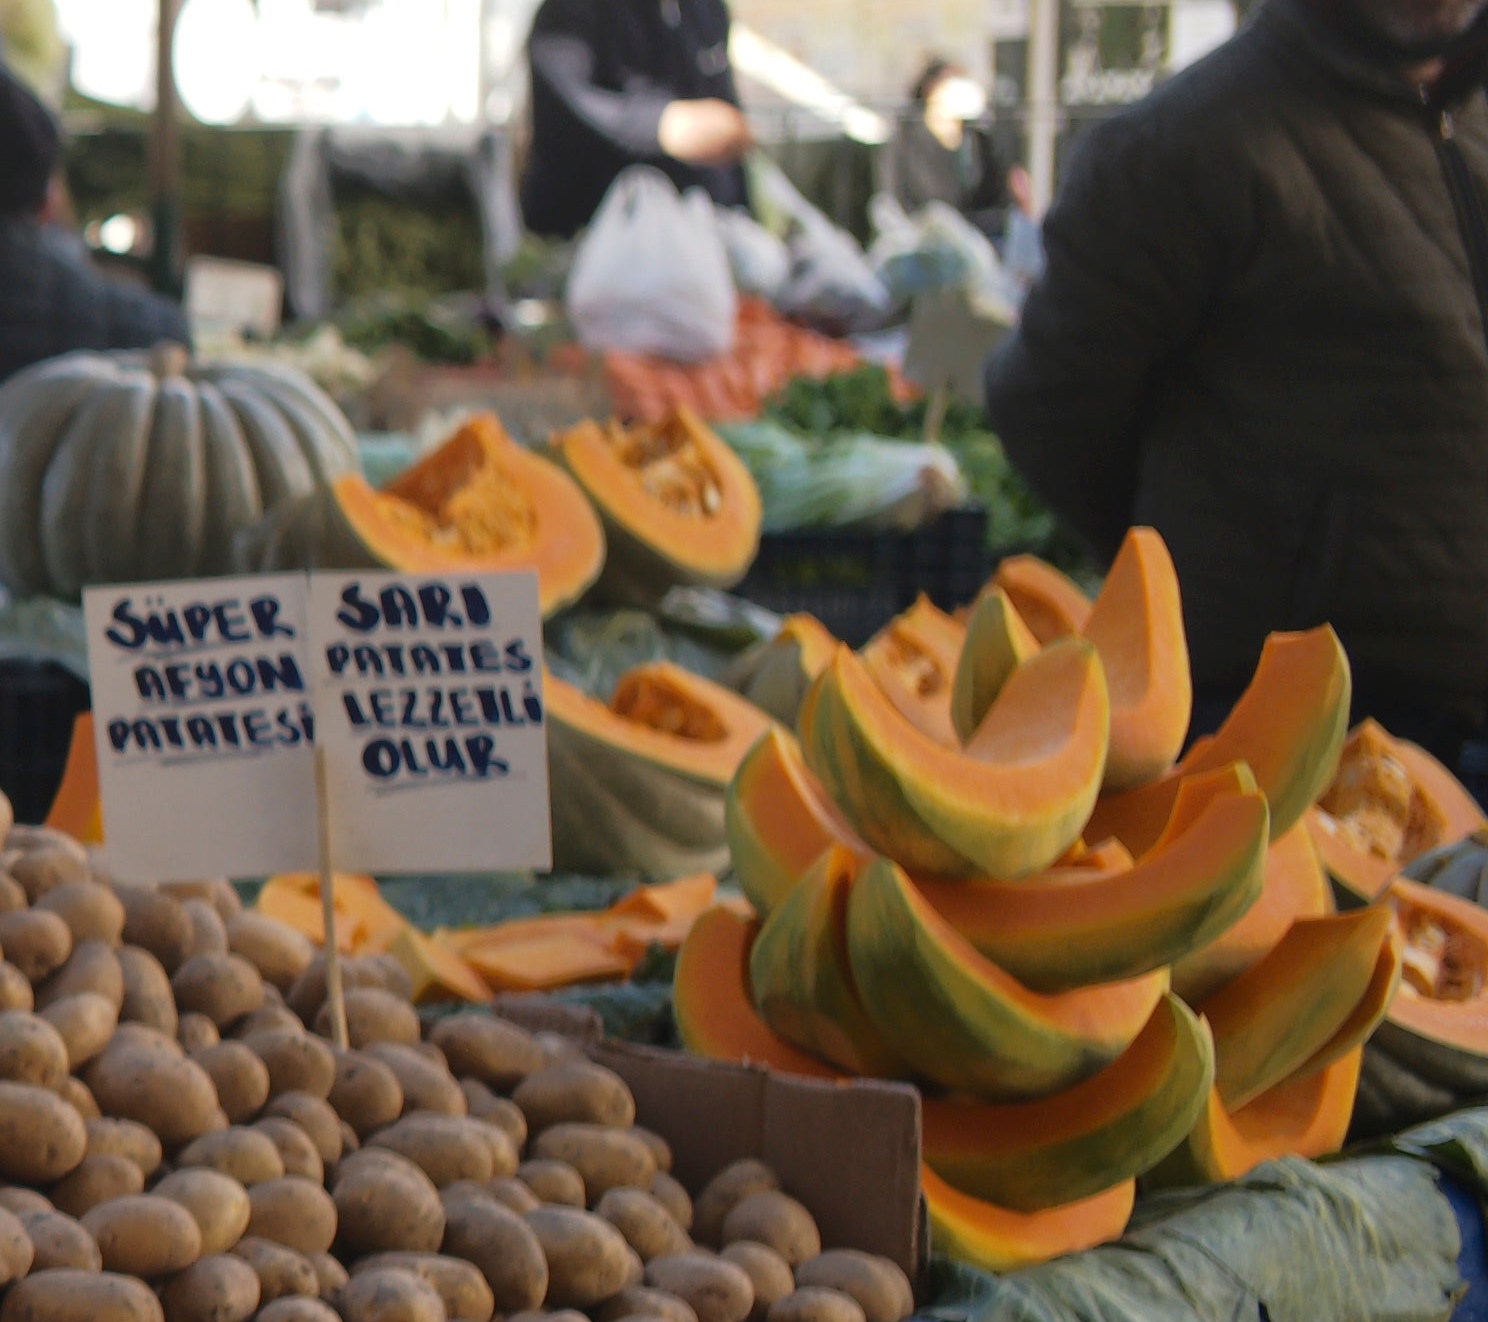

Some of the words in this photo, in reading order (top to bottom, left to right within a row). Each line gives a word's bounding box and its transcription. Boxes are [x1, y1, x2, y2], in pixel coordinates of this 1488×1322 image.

[104, 595, 296, 649] SÜPER
[336, 581, 491, 632] SARI
[134, 654, 305, 703] AFYON
[325, 638, 532, 676] PATATES
[362, 733, 509, 778] OLUR
